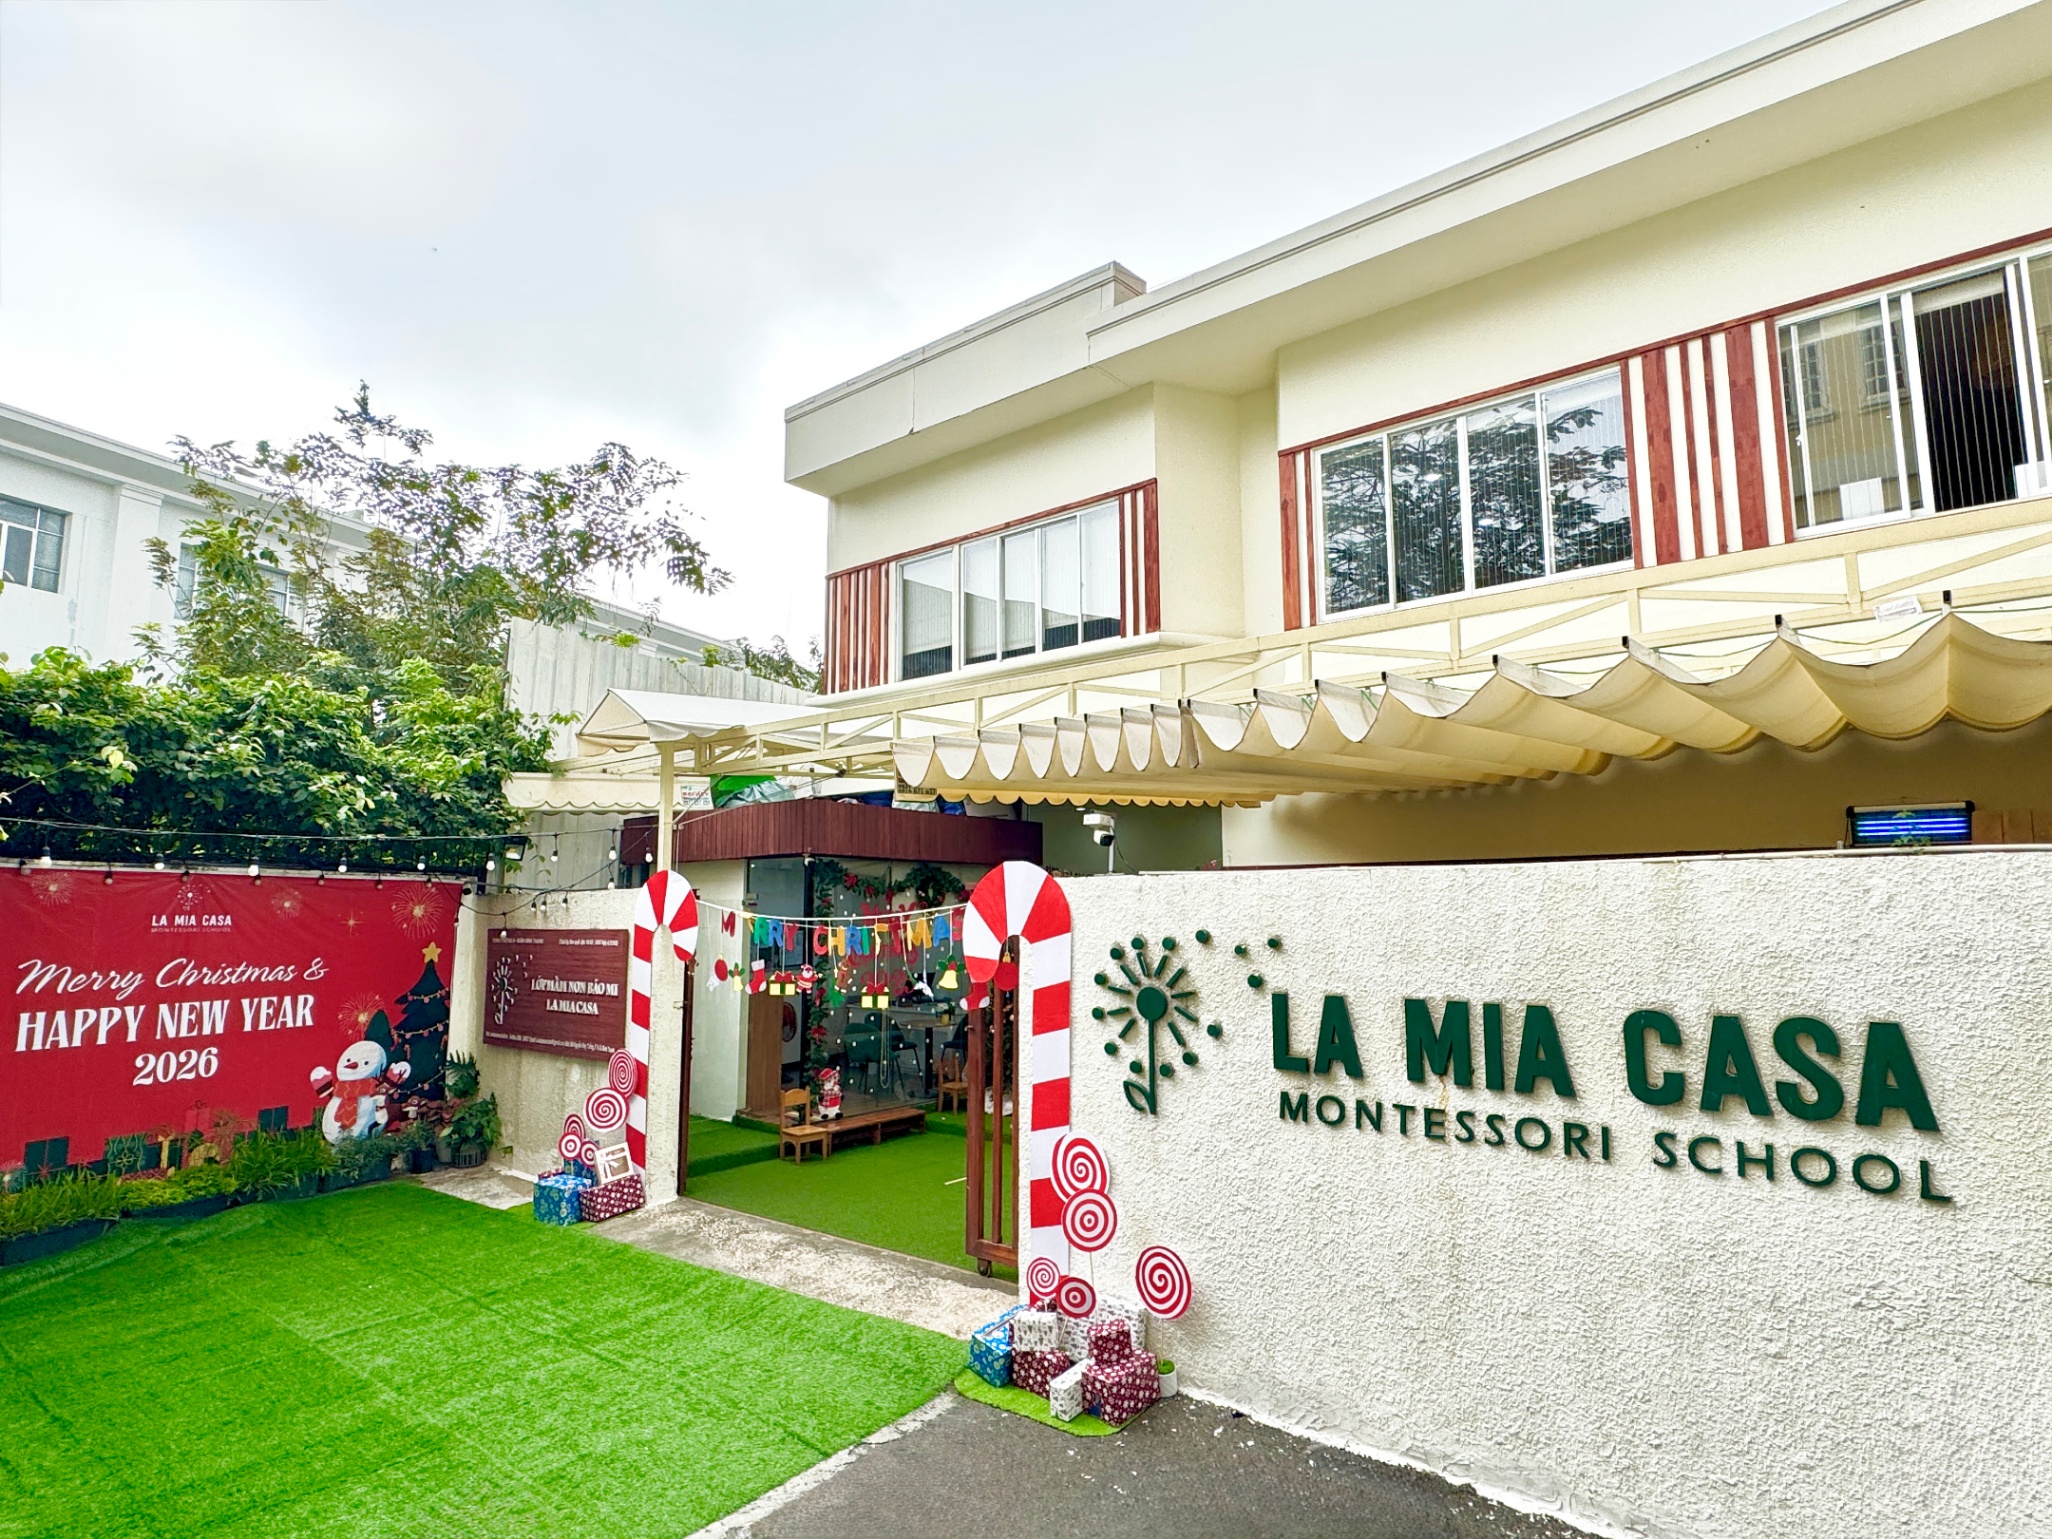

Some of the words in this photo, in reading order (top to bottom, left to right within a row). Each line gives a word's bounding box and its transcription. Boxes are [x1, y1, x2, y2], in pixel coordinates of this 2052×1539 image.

[151, 914, 168, 927] LA
[174, 914, 197, 927] MIA
[202, 914, 232, 927] CASA
[16, 959, 145, 1000] Merry
[155, 957, 298, 988] Christmas
[303, 957, 329, 981] &
[568, 981, 586, 994] NON
[606, 983, 619, 996] MI
[15, 1004, 146, 1052] HAPPY
[155, 999, 230, 1039] NEW
[240, 994, 315, 1032] YEAR
[546, 999, 558, 1011] LA
[559, 1000, 576, 1013] MIA
[576, 1001, 599, 1015] CASA
[132, 1047, 219, 1086] 2026
[1271, 993, 1364, 1080] LA
[1404, 998, 1578, 1101] MIA
[1623, 1009, 1941, 1133] CASA
[1279, 1090, 1610, 1161] MONTESSORI
[1653, 1131, 1953, 1203] SCHOOL
